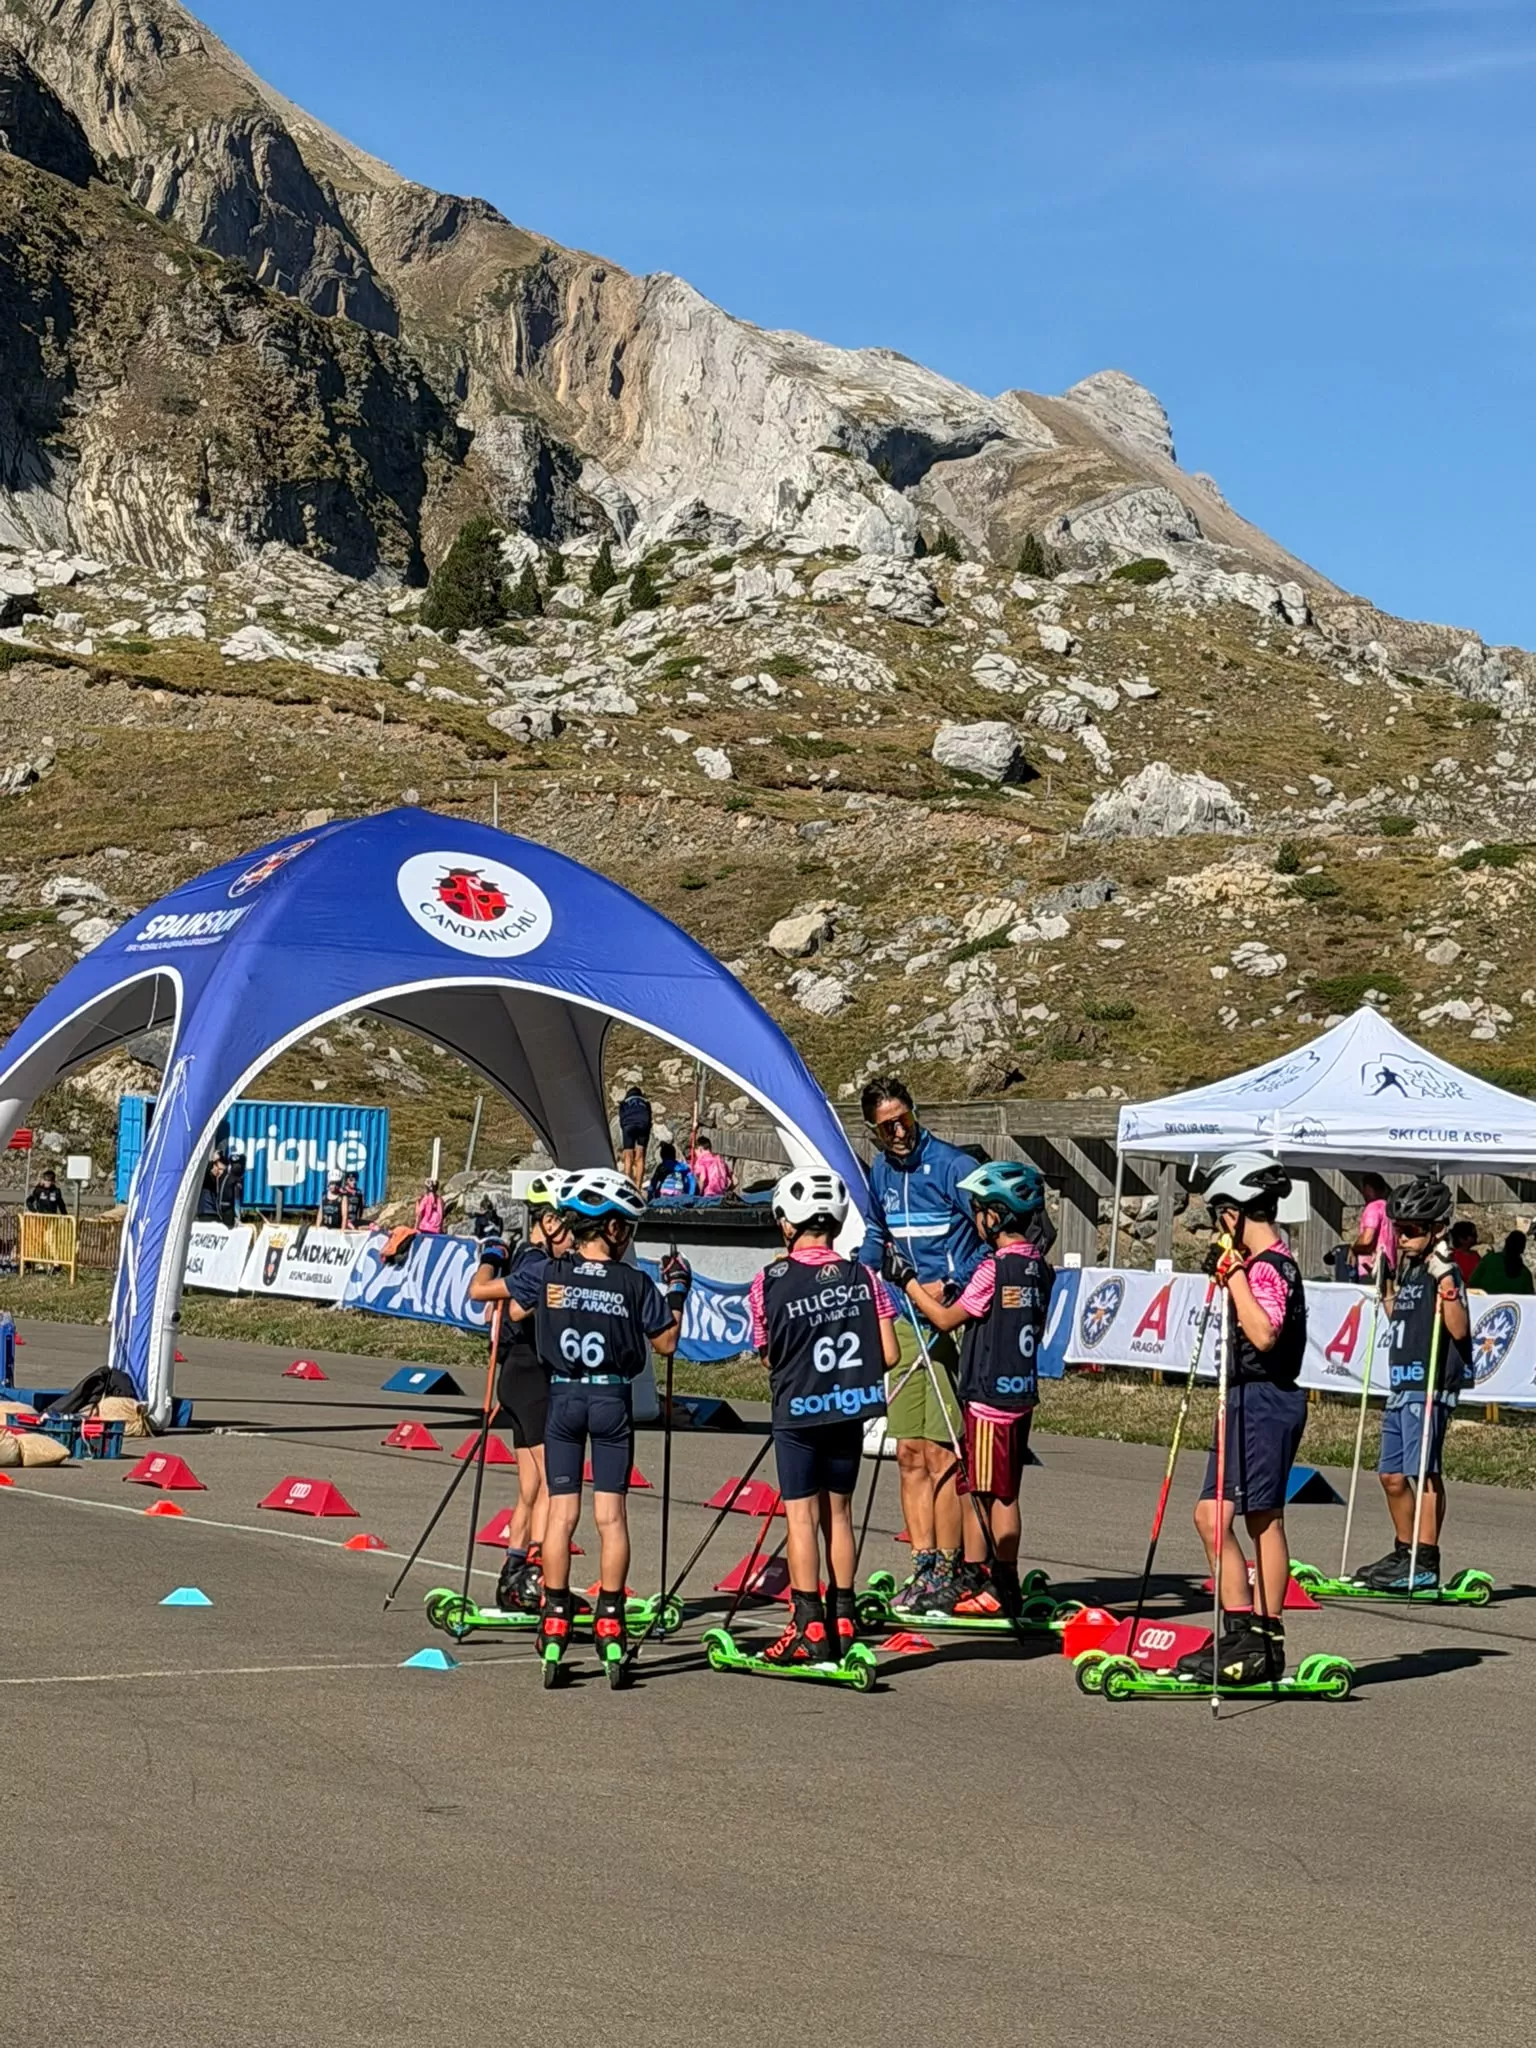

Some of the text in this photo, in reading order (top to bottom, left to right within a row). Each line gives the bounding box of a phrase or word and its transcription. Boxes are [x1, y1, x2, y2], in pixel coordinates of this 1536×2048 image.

[419, 902, 538, 943] CANDANCHU
[1388, 1128, 1503, 1144] SKI CLUB ASPE
[563, 1297, 579, 1310] DE
[564, 1286, 624, 1305] GOBIERNO
[560, 1327, 605, 1368] 66
[813, 1331, 863, 1373] 62
[1019, 1324, 1034, 1357] 6
